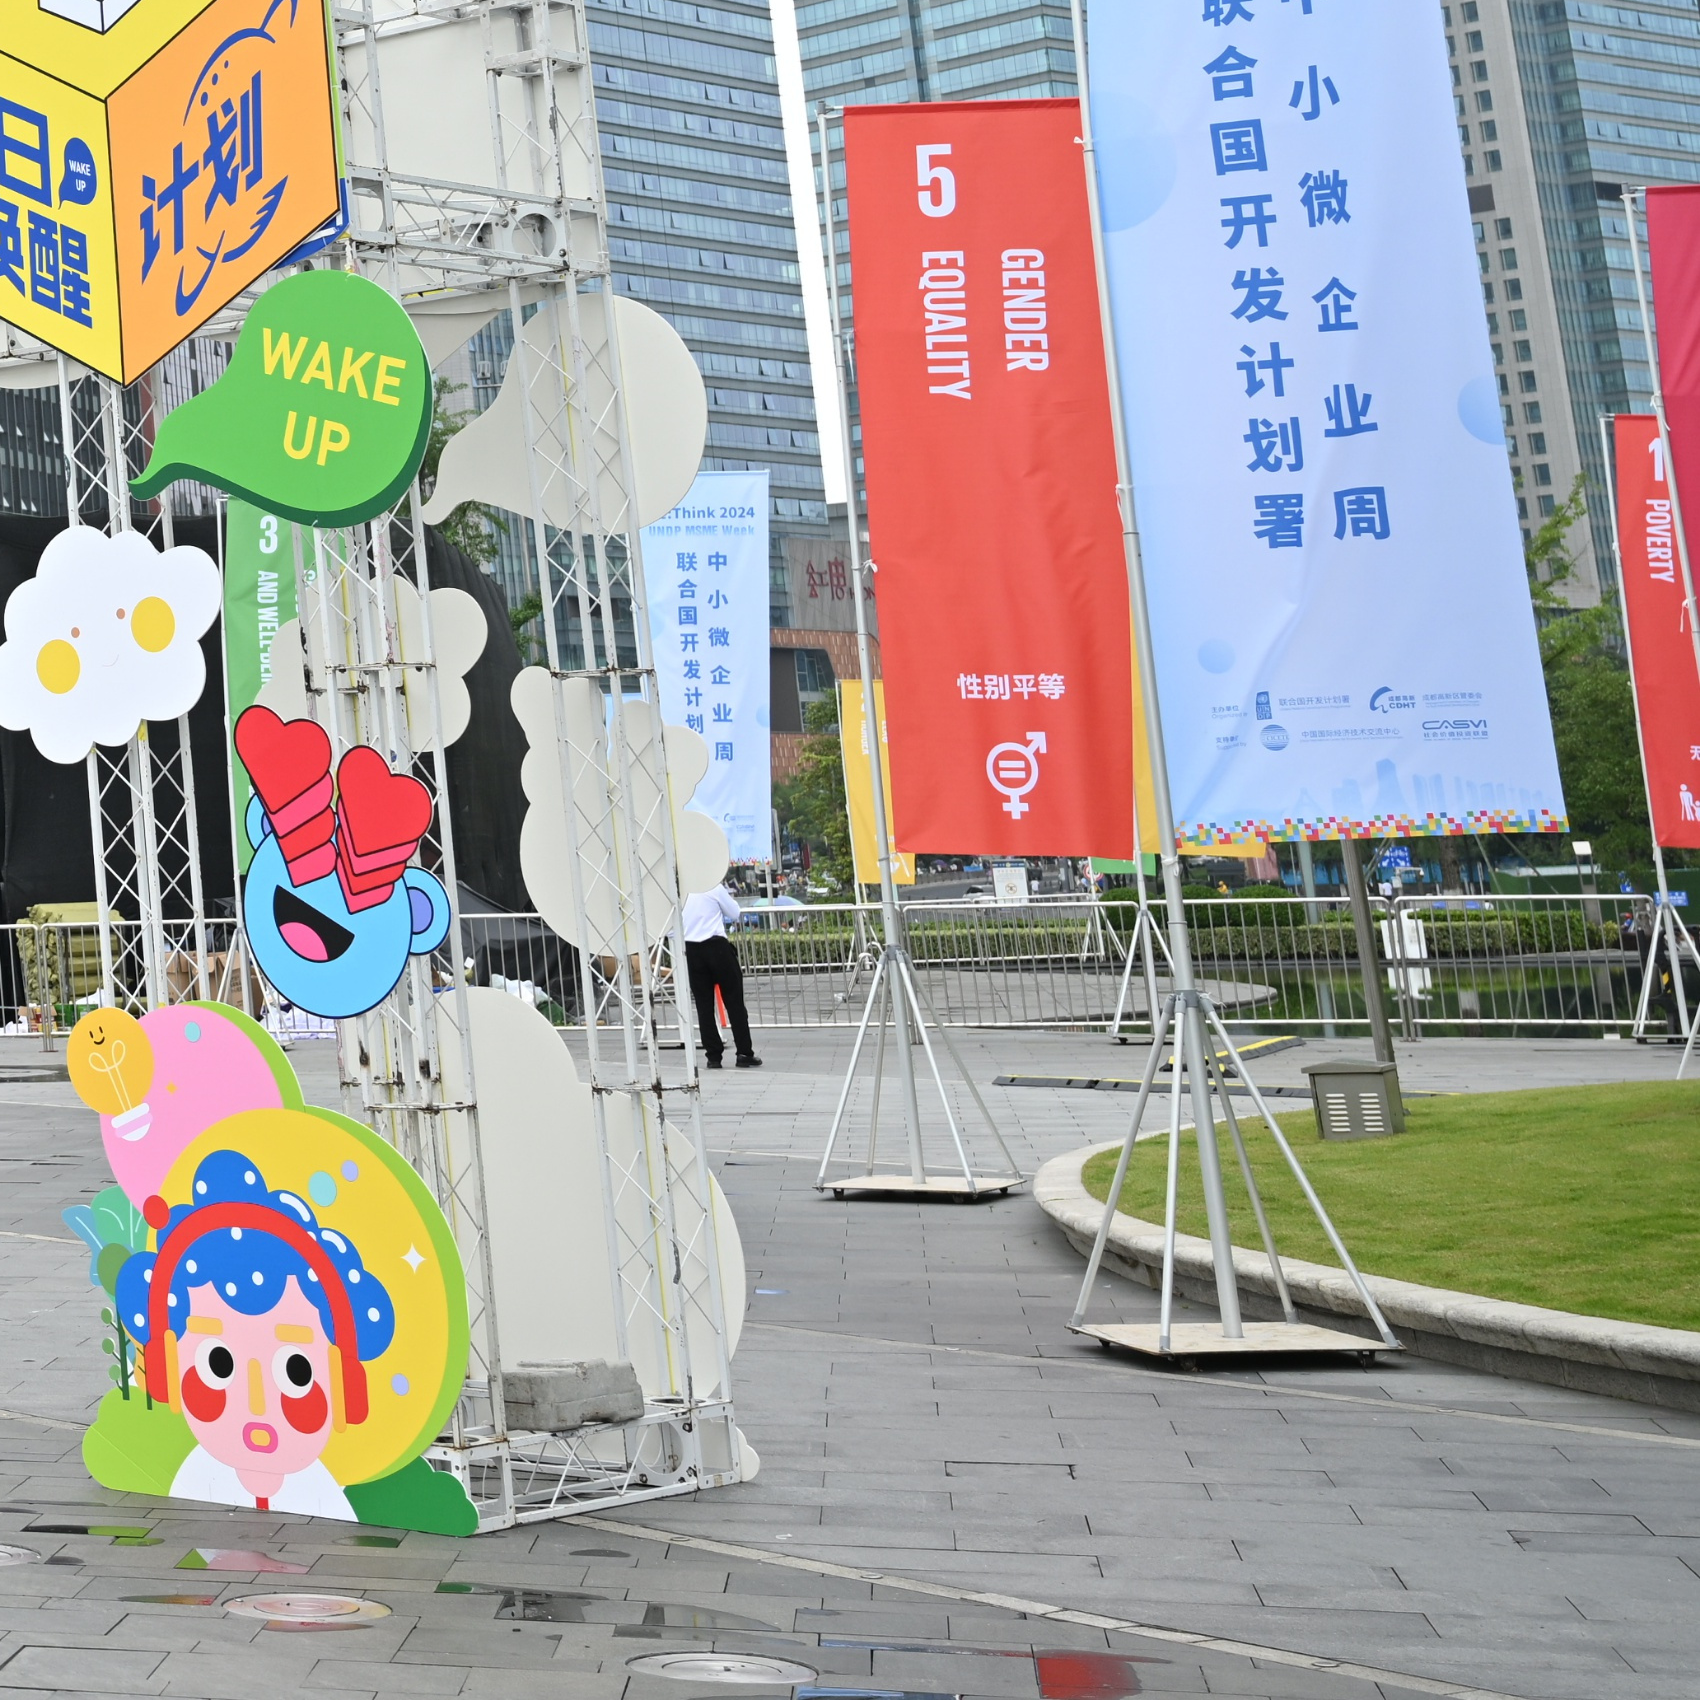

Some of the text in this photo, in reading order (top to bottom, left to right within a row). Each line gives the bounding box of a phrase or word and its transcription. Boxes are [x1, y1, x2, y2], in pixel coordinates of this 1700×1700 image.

[68, 157, 91, 177] WAKE
[75, 177, 86, 192] UP
[139, 70, 263, 285] 计划
[916, 143, 957, 217] 5
[918, 251, 972, 400] EQUALITY
[1001, 248, 1049, 372] GENDER
[261, 326, 406, 407] WAKE
[282, 411, 350, 467] UP
[1648, 437, 1664, 482] 1
[649, 525, 755, 537] UNDP MSME Week
[660, 507, 755, 519] :Think 2024
[259, 515, 278, 554] 3
[1645, 499, 1675, 583] POVERTY
[257, 570, 279, 604] AND
[676, 552, 704, 734] 联合国开发计划
[707, 551, 734, 761] 中小微企业周
[956, 673, 1066, 700] 性别平等
[1279, 695, 1350, 706] 联合国开发计划署
[1301, 728, 1400, 738] 中国国际经济技术交流中心
[1422, 719, 1487, 730] CASVI
